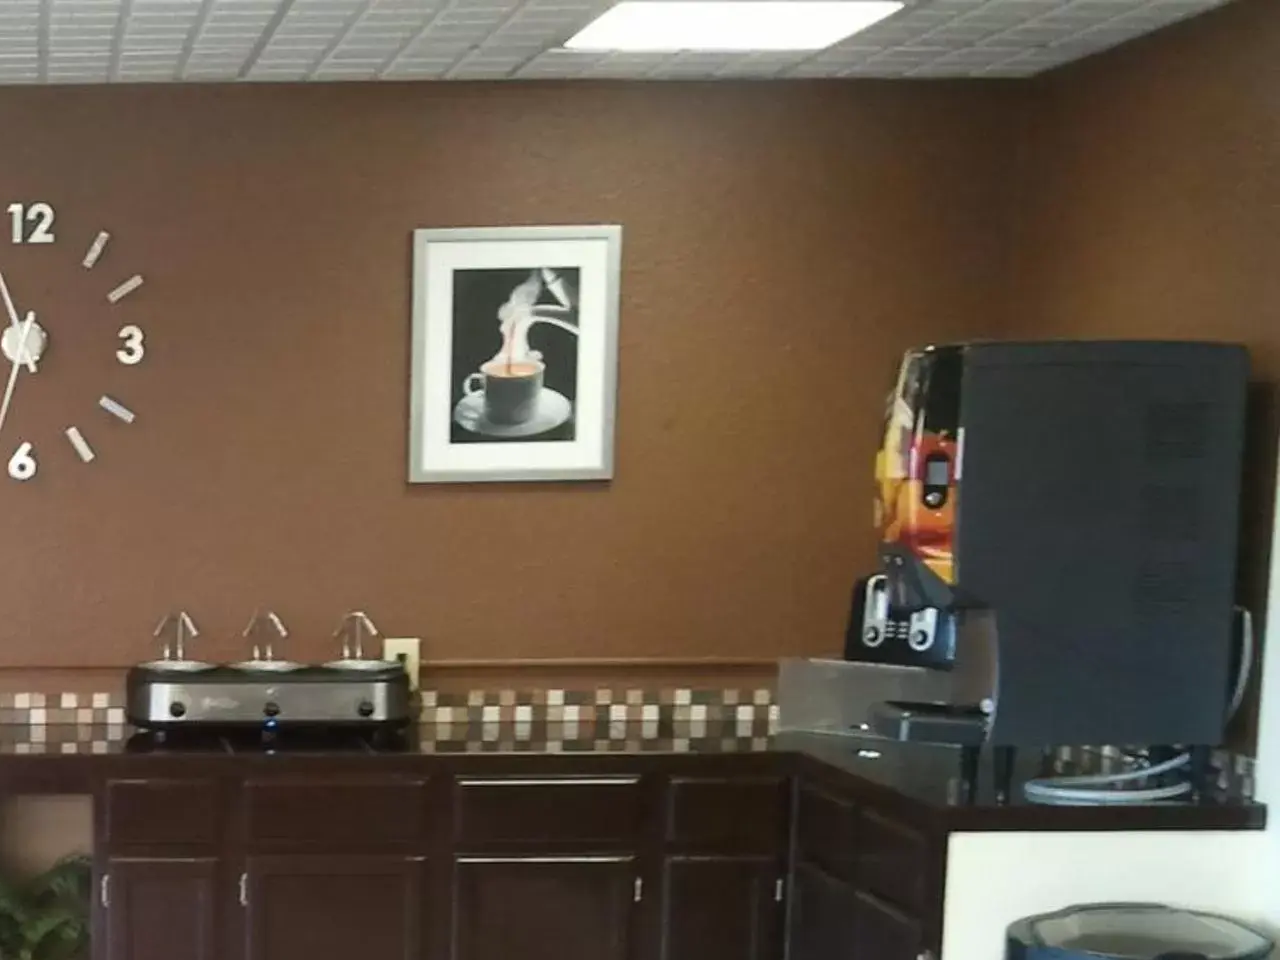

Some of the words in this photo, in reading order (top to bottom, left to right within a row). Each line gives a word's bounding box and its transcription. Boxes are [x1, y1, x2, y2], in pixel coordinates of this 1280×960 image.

[7, 203, 54, 243] 12
[116, 325, 144, 364] 3
[8, 441, 36, 480] 6
